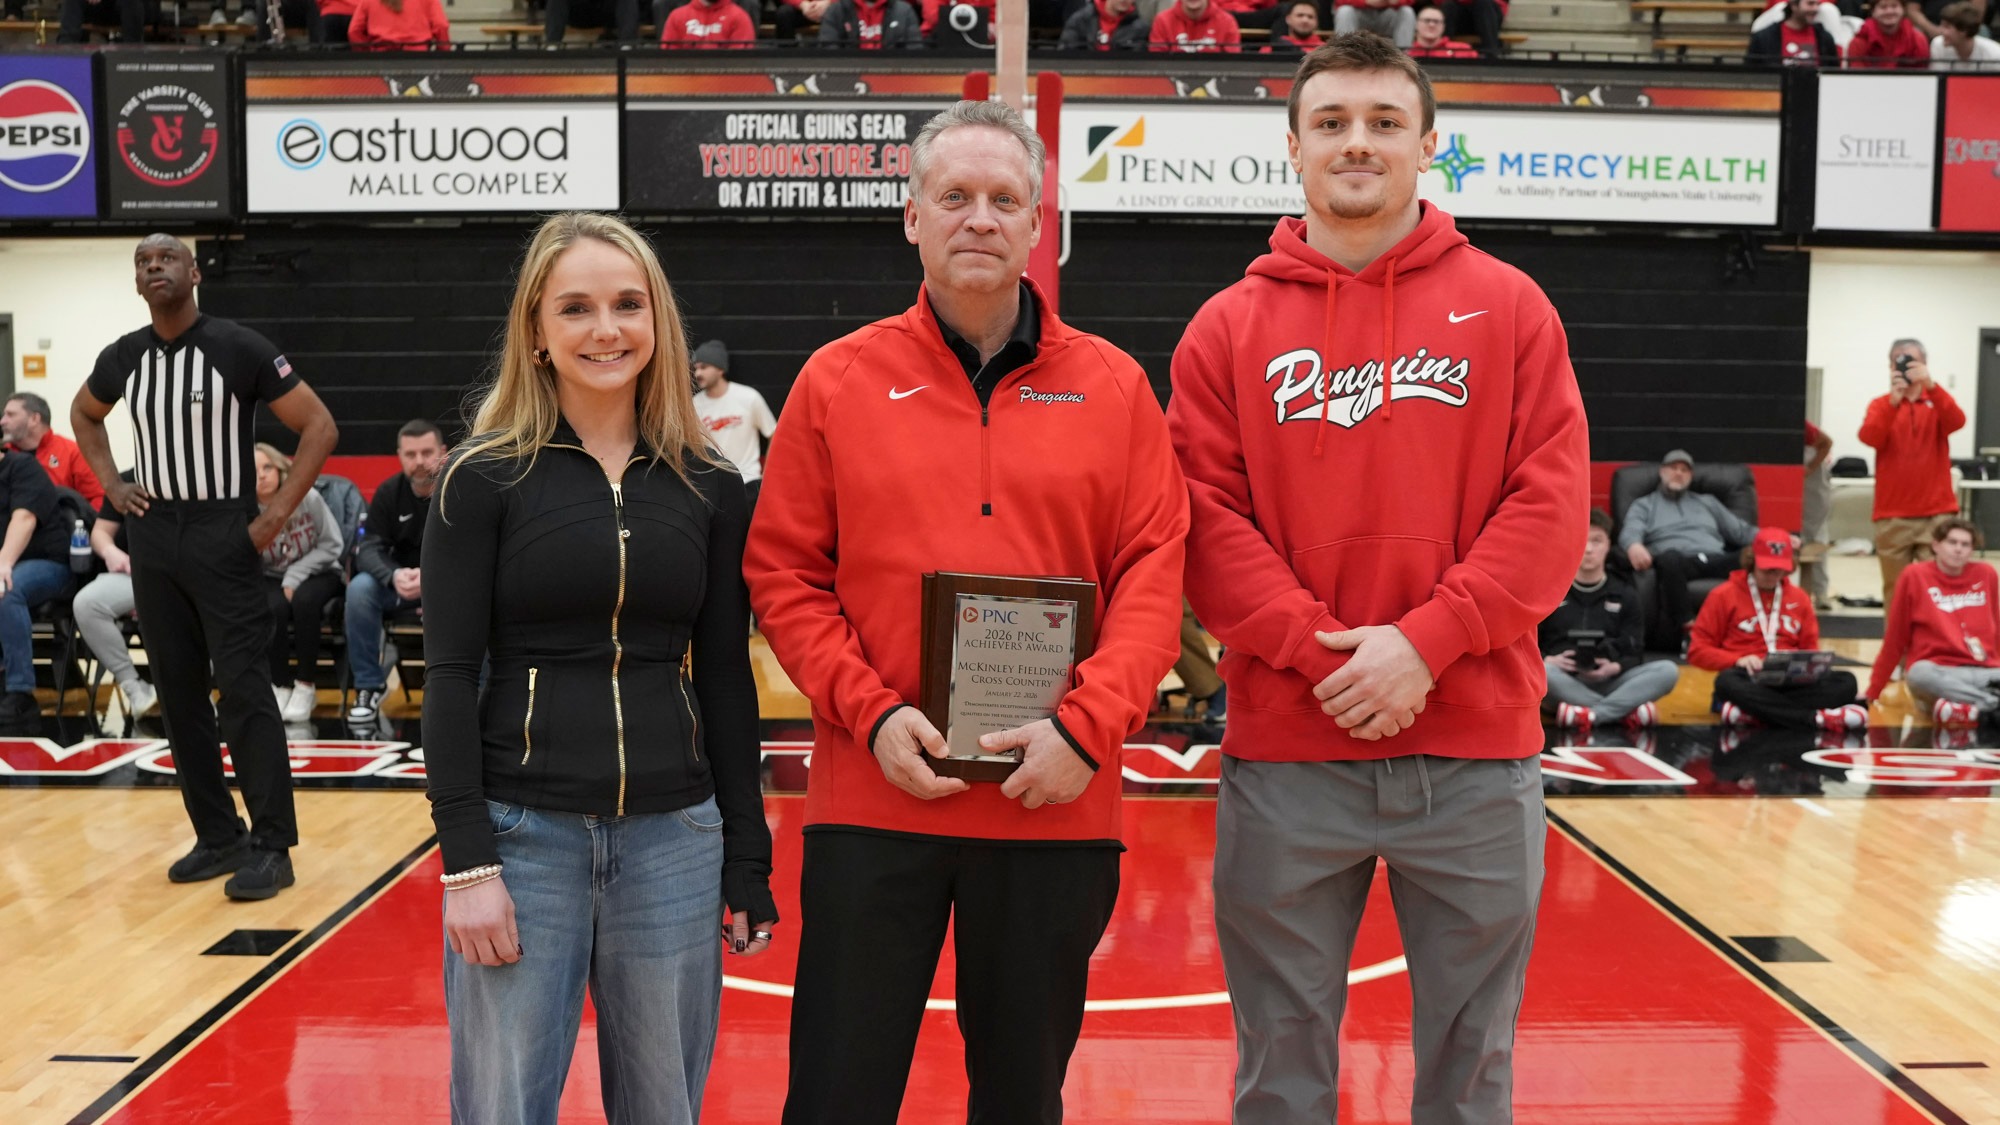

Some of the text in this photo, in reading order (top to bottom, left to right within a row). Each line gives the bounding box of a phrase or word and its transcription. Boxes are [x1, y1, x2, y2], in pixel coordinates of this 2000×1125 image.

[120, 85, 214, 118] THE VARSITY CLUB
[726, 113, 907, 140] OFFICIAL GUINS GEAR
[282, 116, 568, 163] eastwood
[1838, 134, 1911, 159] STIFEL
[1945, 137, 2000, 164] KNIG
[699, 143, 912, 177] YSUBOOKSTORE.CO
[1120, 154, 1215, 183] PENN
[349, 172, 568, 196] MALL COMPLEX
[718, 181, 742, 208] OR
[745, 181, 769, 208] AT
[771, 181, 820, 208] FIFTH
[823, 181, 837, 208] &
[1116, 196, 1127, 207] A
[1131, 195, 1179, 208] LINDY
[1183, 195, 1239, 208] GROUP
[190, 391, 204, 402] TW
[1019, 385, 1085, 405] Penguins
[982, 609, 1019, 624] PNC
[1043, 611, 1068, 628] Y
[964, 639, 1063, 653] ACHIEVERS AWARD
[985, 629, 1045, 643] 2026 PNC
